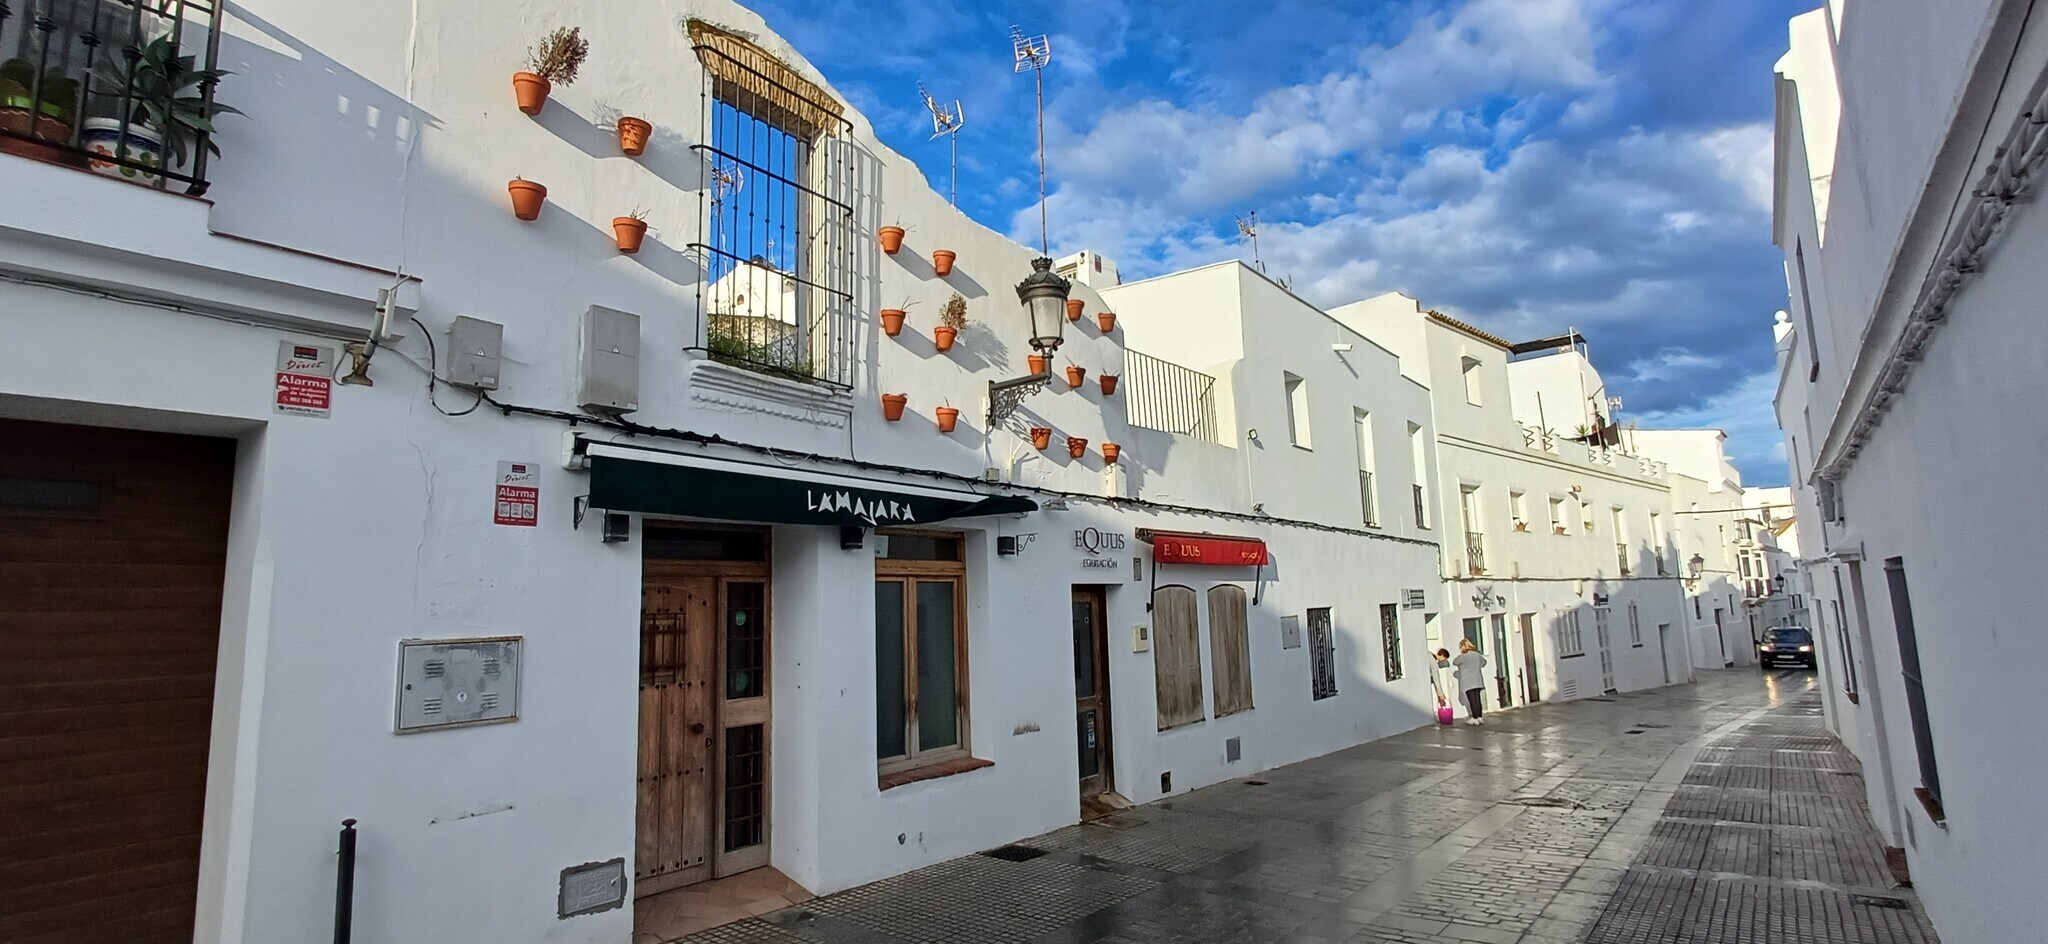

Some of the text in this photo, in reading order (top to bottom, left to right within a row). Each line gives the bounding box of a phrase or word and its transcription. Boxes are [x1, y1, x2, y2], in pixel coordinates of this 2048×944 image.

[279, 375, 328, 388] Alarma
[499, 487, 535, 498] Alarma
[1074, 527, 1125, 554] EQUUS
